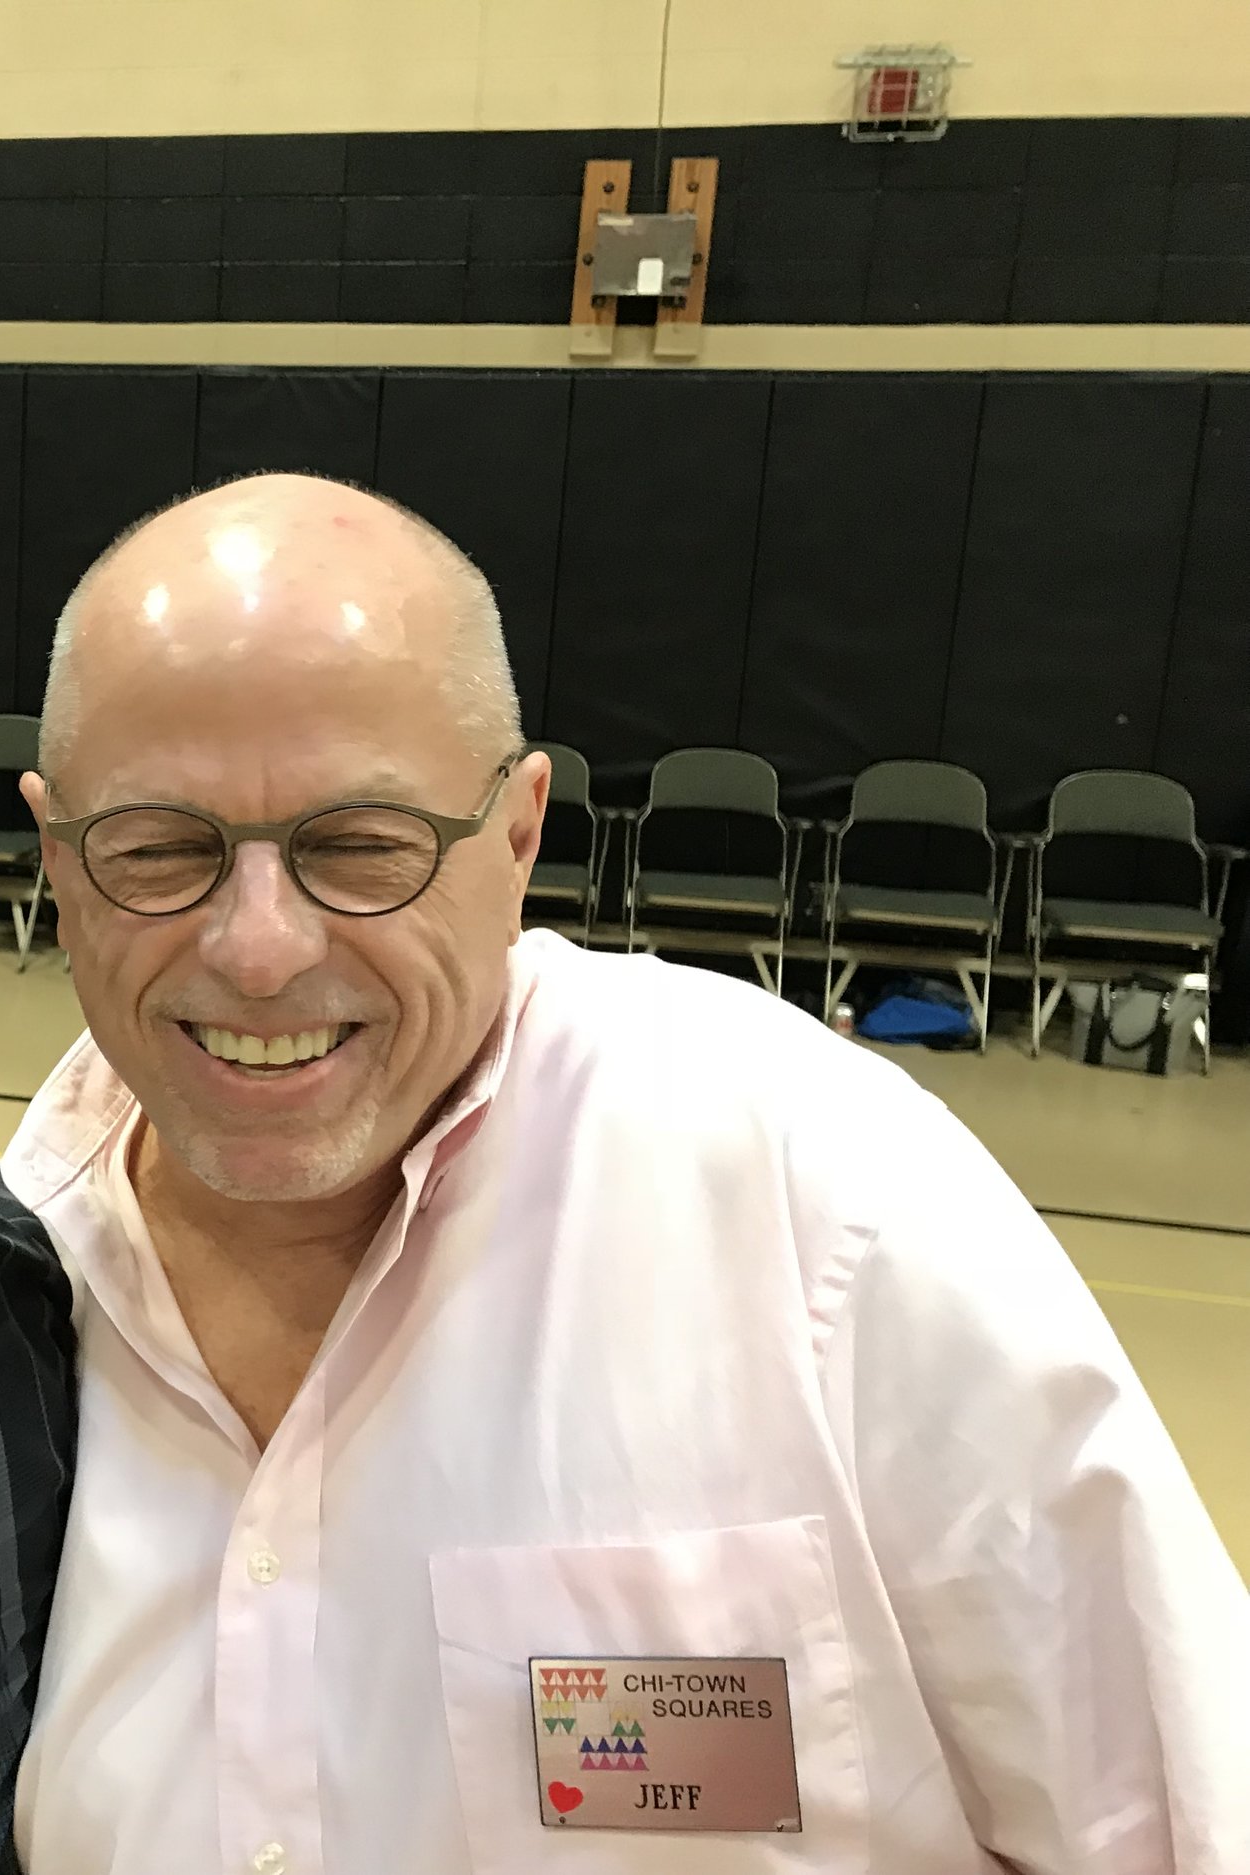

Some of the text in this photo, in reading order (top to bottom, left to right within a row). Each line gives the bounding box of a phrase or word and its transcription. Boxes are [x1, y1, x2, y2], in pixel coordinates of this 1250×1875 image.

[623, 1674, 746, 1693] CHI-TOWN
[652, 1699, 773, 1719] SQUARES
[634, 1784, 702, 1810] JEFF
